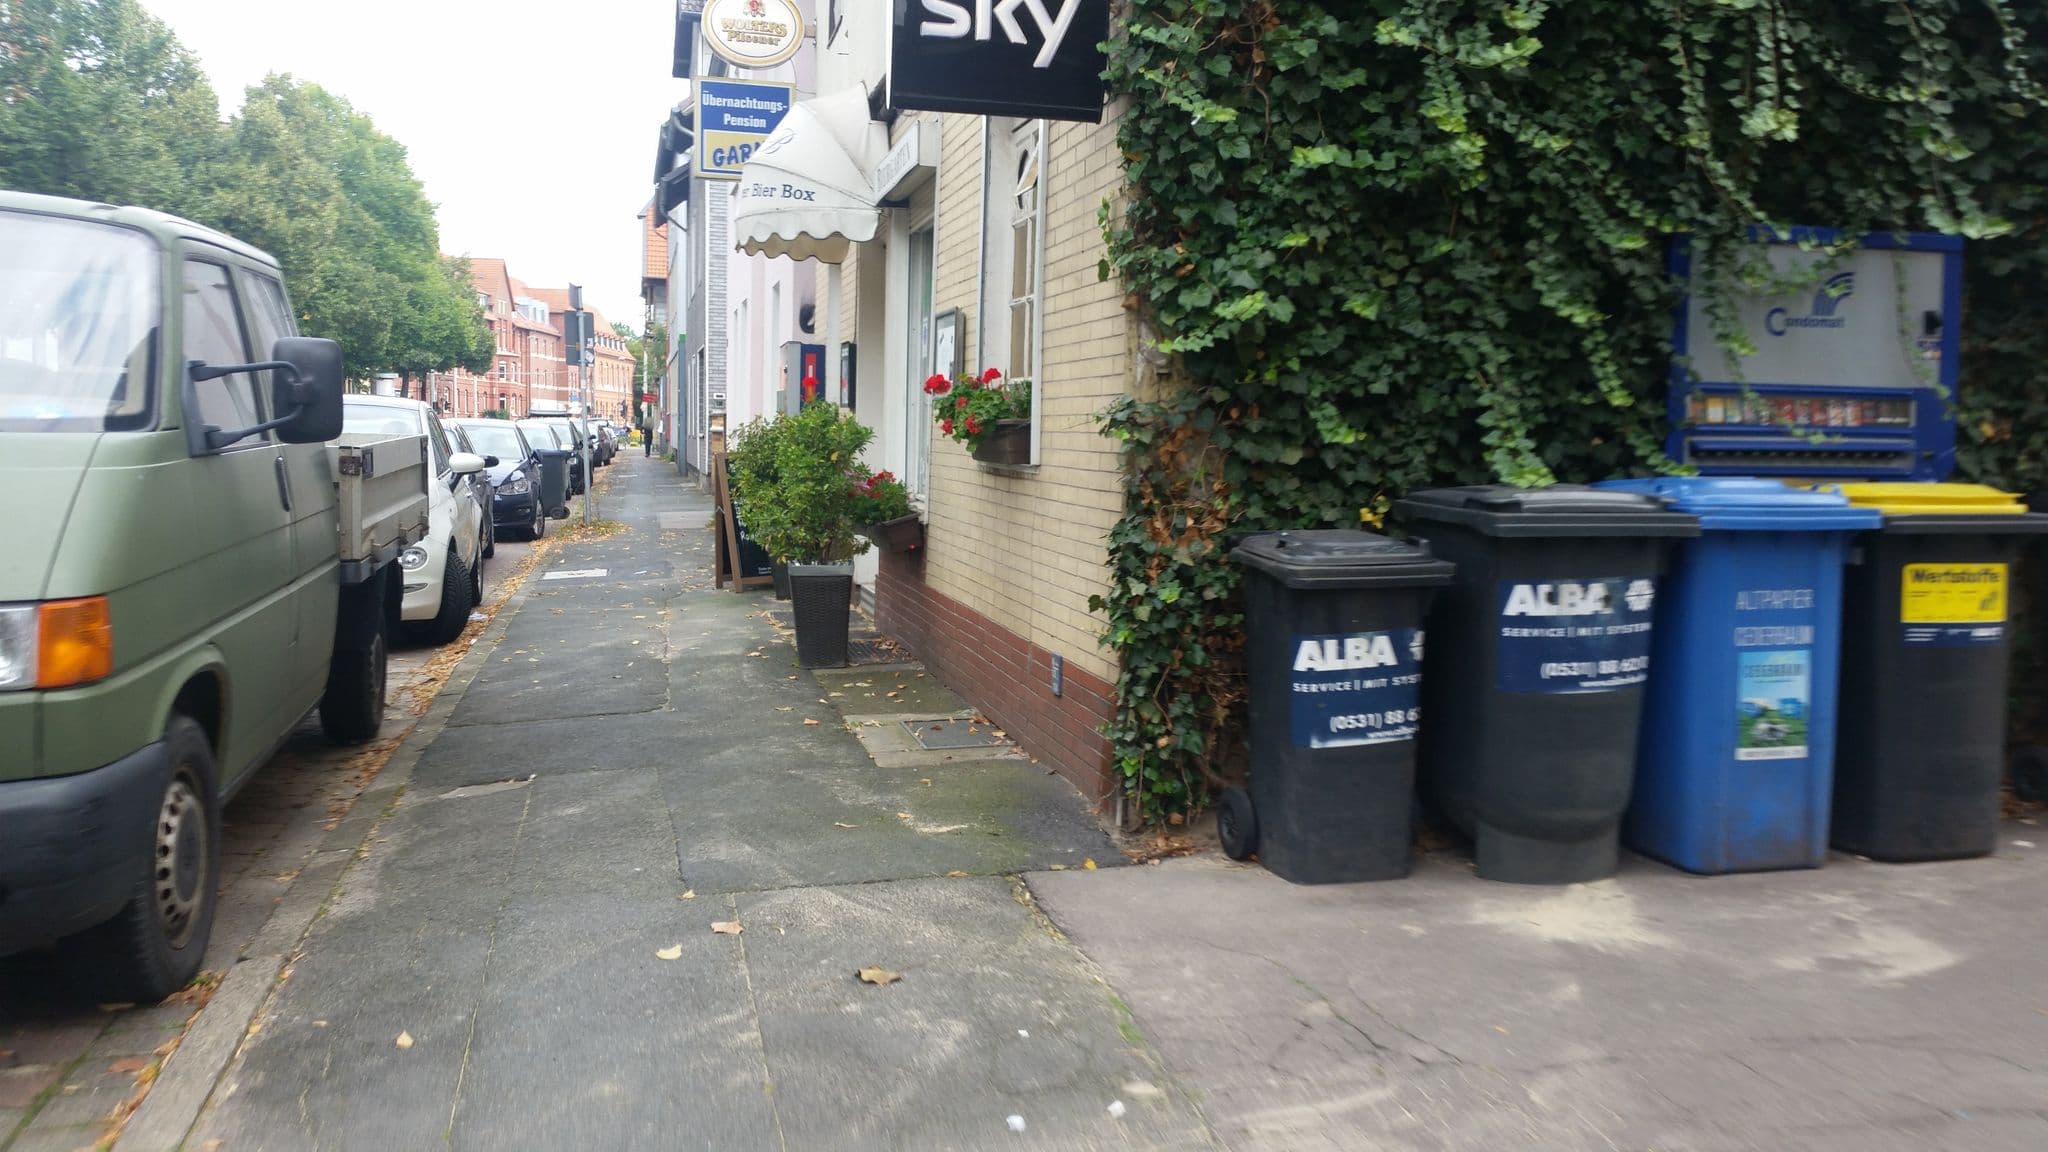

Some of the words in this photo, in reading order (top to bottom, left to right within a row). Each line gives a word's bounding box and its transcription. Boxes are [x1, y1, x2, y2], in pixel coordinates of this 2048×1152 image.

[721, 18, 787, 37] WOLTERS
[727, 31, 780, 46] Pilsener
[702, 90, 788, 114] Übernachtungs-
[723, 113, 767, 128] Pension
[752, 183, 777, 198] Bier
[780, 184, 816, 202] Box
[1911, 568, 2000, 584] Wertstoffe
[1502, 583, 1616, 616] ALBA
[1501, 627, 1566, 637] SERVICE
[1293, 636, 1398, 671] ALBA
[1292, 681, 1352, 693] SERVICE
[1329, 713, 1383, 732] (0531)
[1384, 710, 1405, 724] 88
